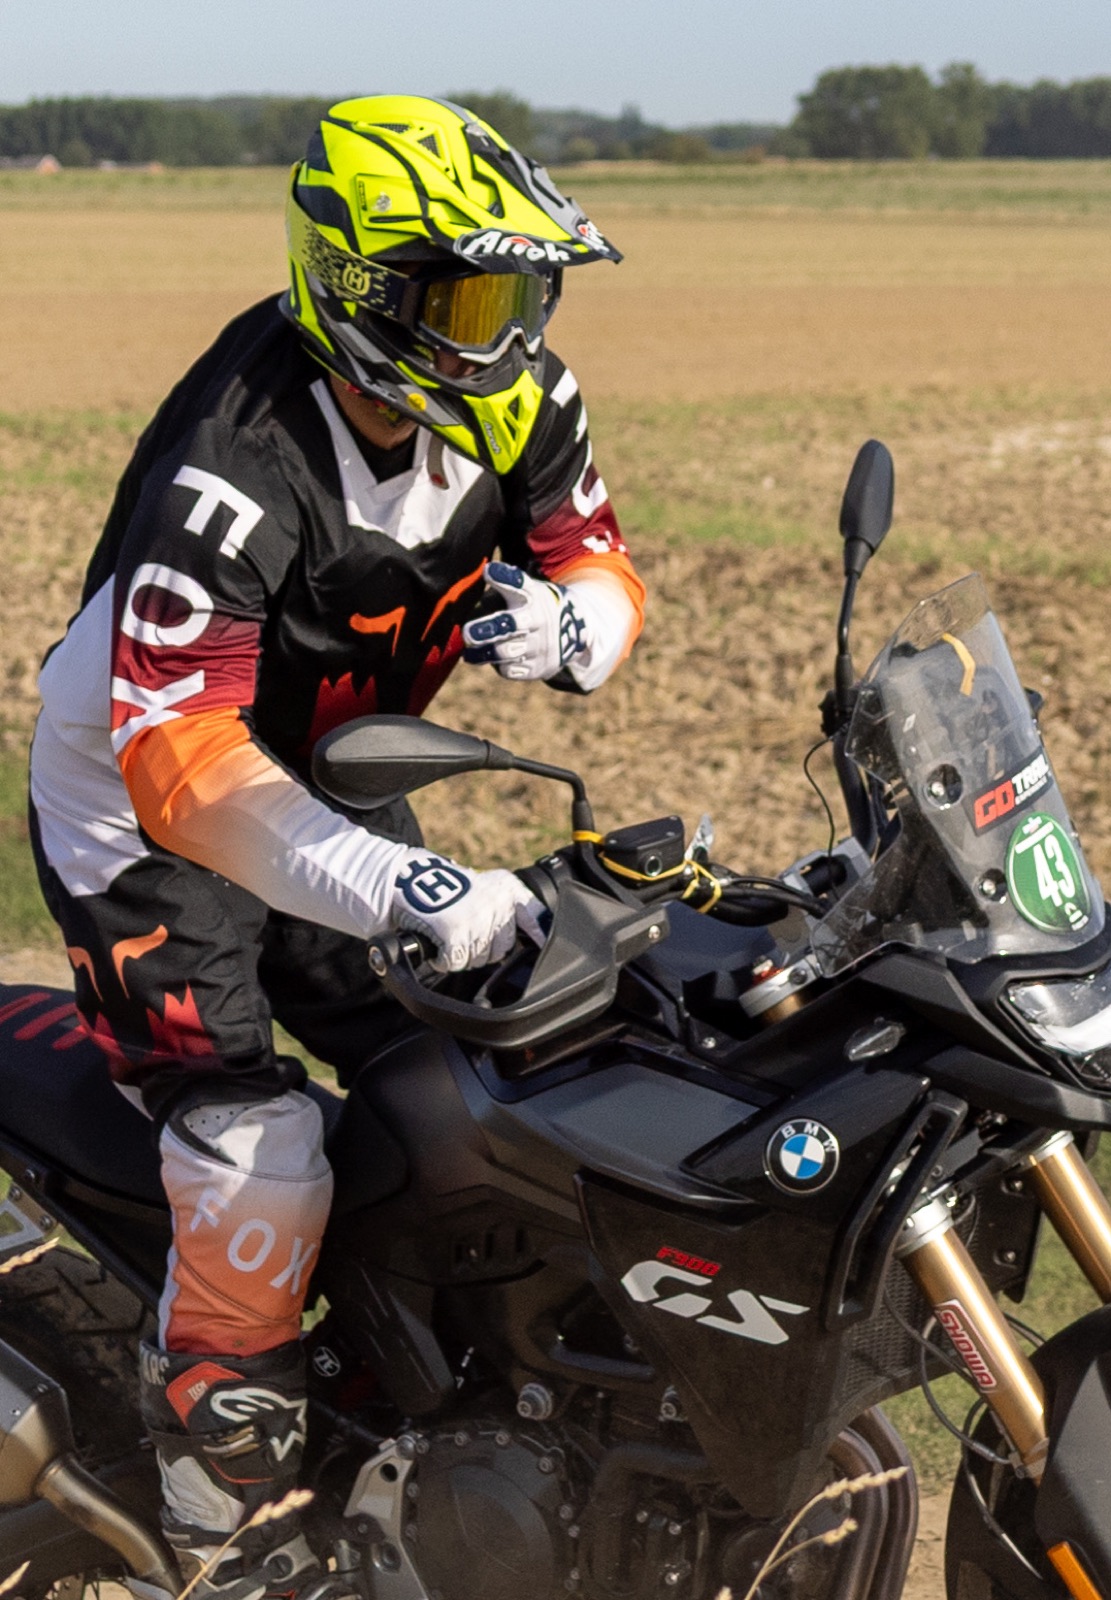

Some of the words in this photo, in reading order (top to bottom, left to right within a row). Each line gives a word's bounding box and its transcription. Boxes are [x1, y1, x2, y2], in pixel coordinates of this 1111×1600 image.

[111, 464, 264, 754] FOX
[1033, 834, 1076, 907] 43
[780, 1121, 836, 1153] BMW
[189, 1187, 317, 1296] FOX
[656, 1246, 721, 1277] F900
[937, 1308, 996, 1390] SHOWA
